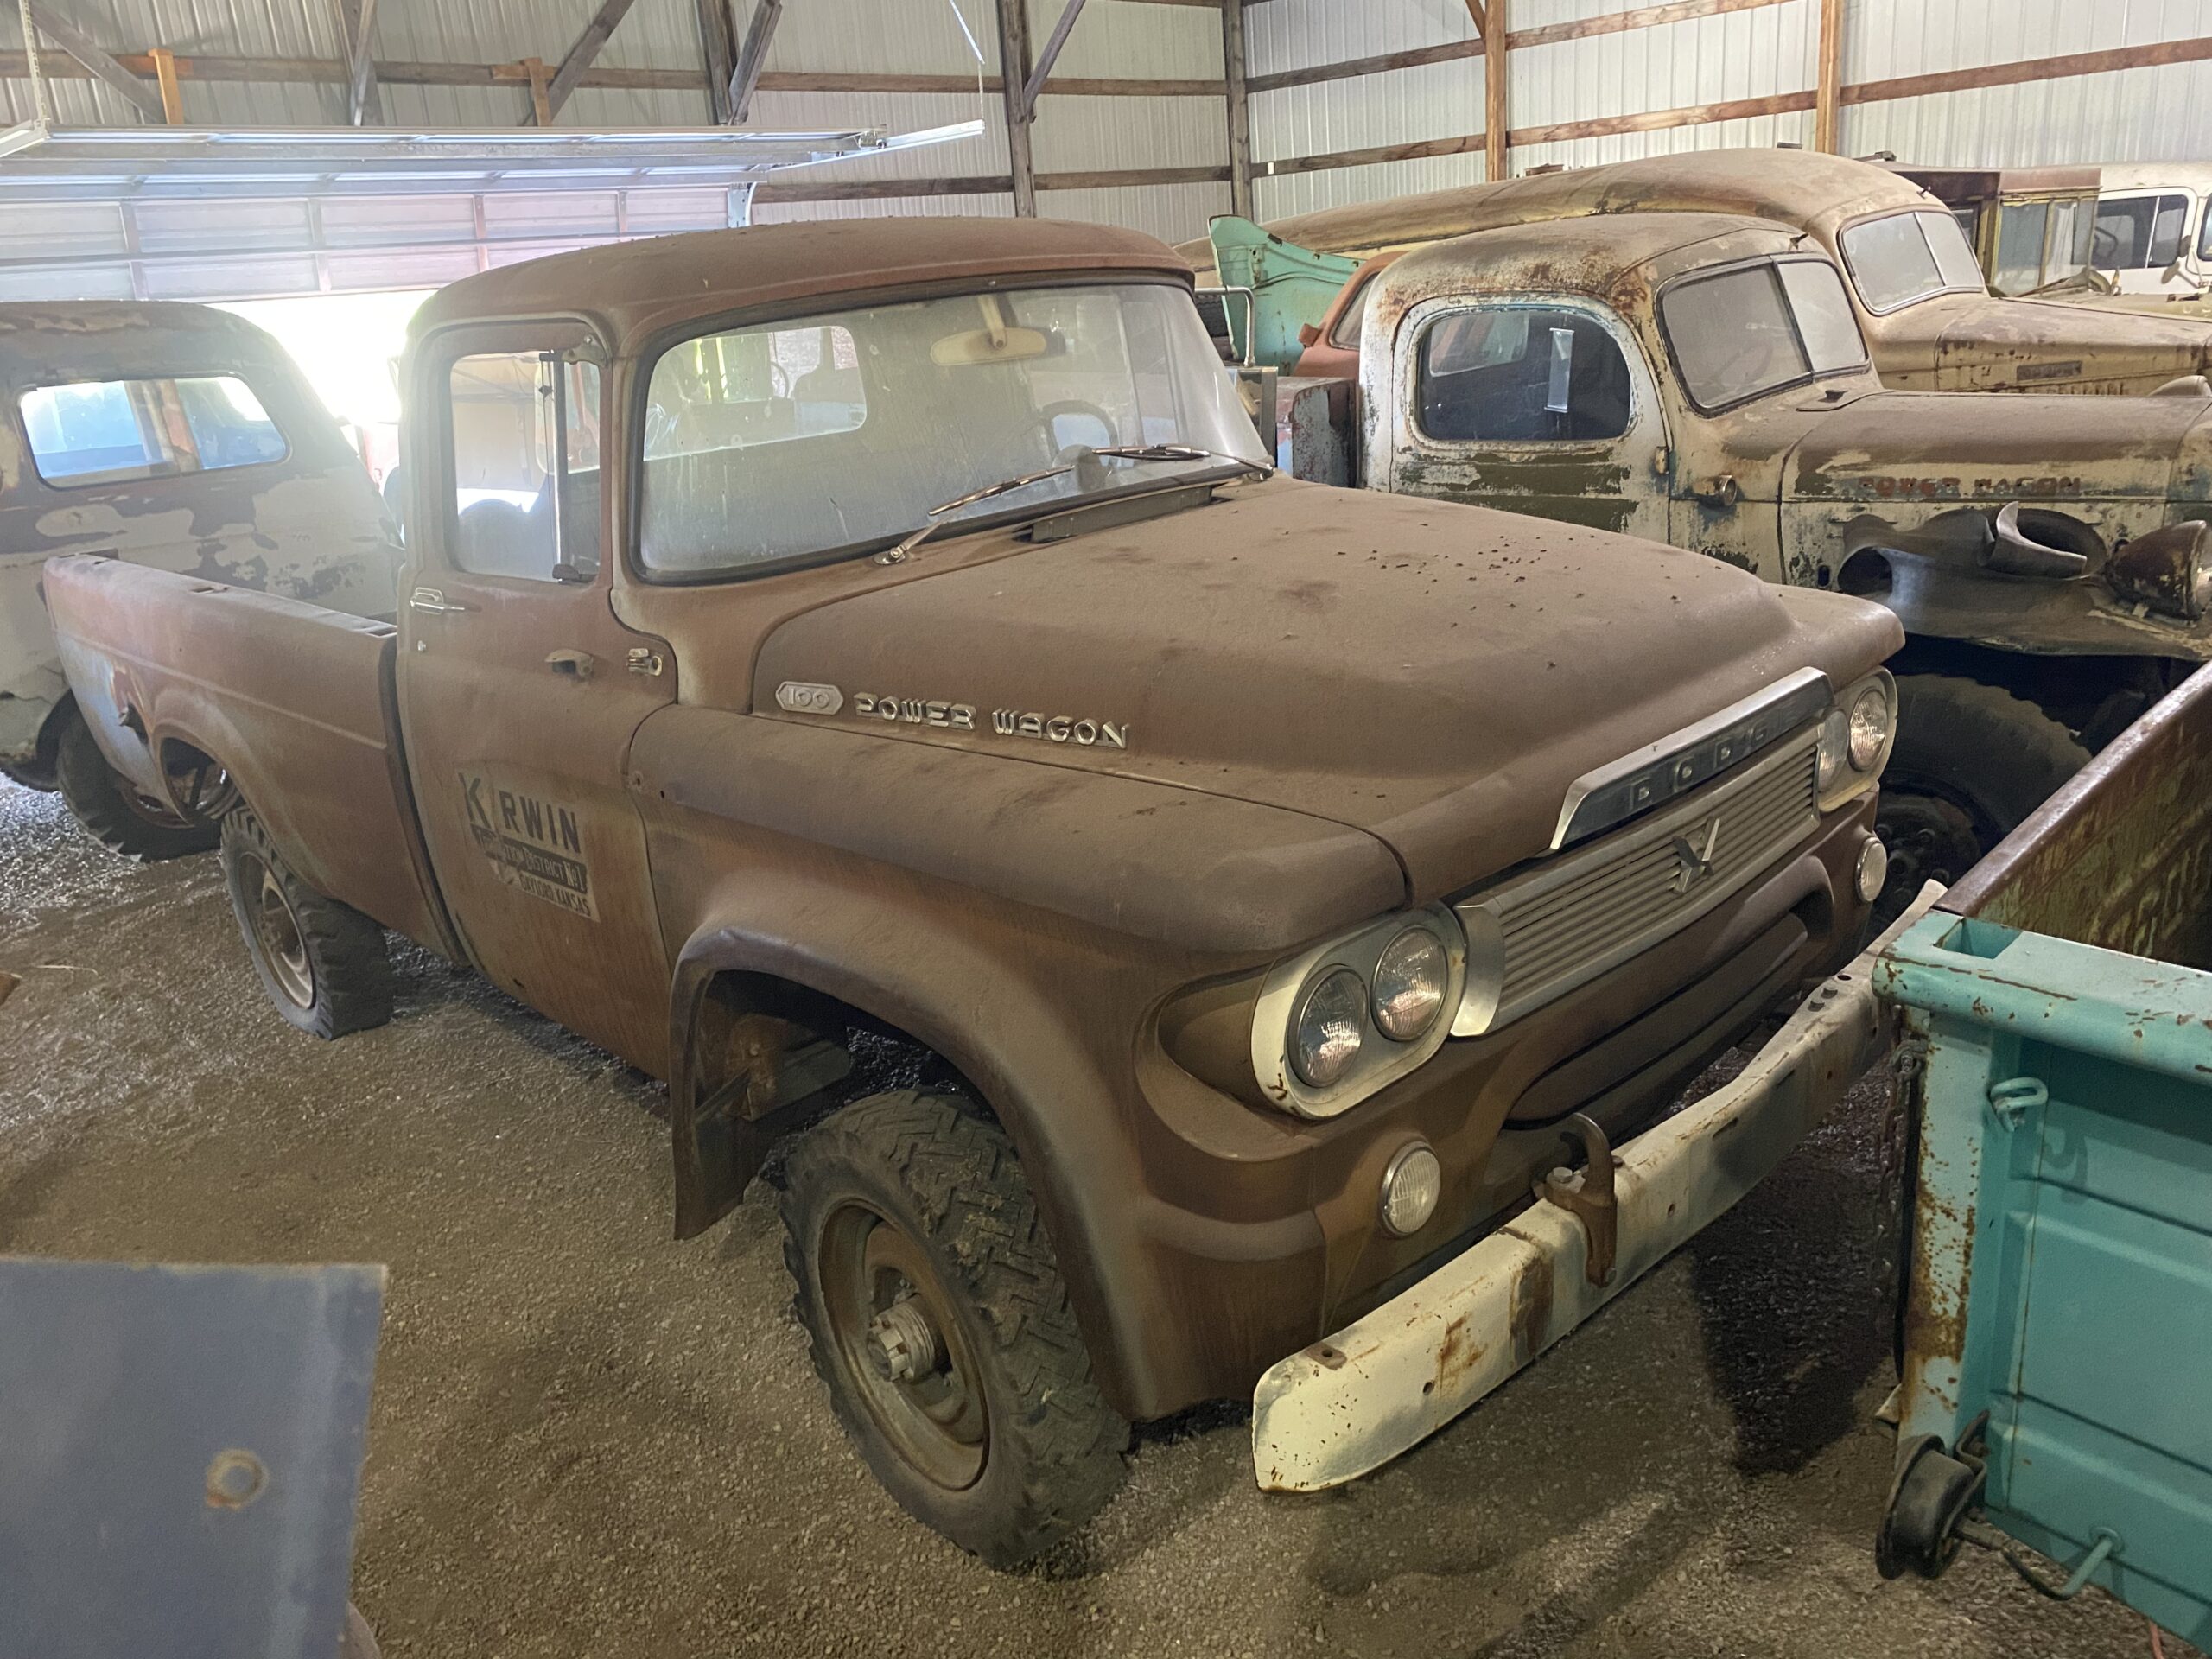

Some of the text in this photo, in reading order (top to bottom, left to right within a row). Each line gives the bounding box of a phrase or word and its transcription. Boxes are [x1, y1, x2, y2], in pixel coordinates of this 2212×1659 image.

[787, 687, 830, 709] 100
[853, 692, 1130, 749] POWER WAGON
[1629, 701, 1800, 810] DODGE
[459, 772, 582, 854] KRWIN
